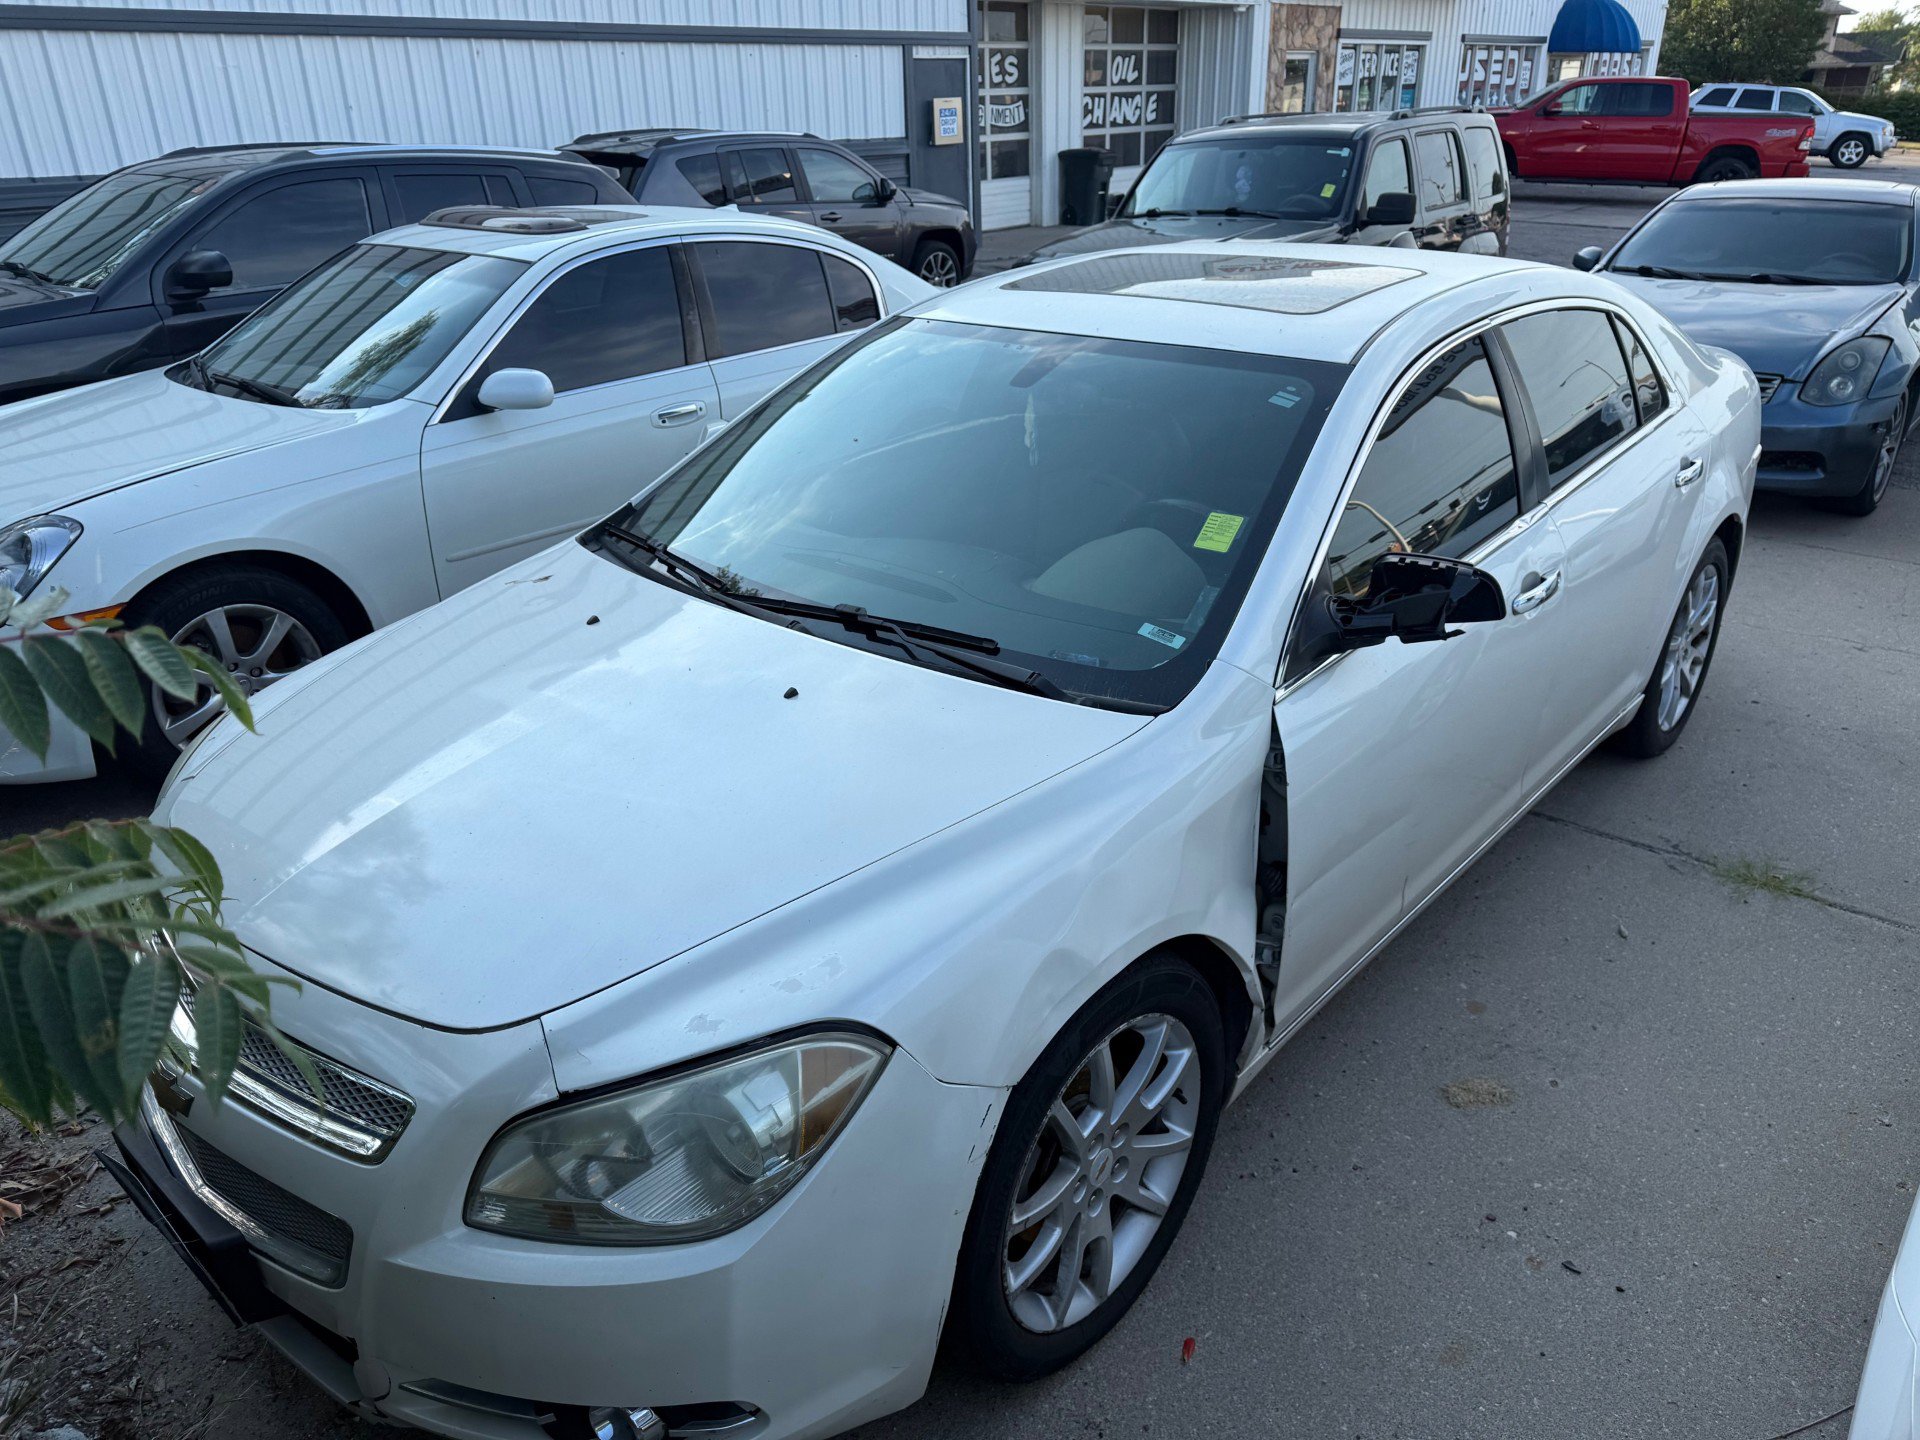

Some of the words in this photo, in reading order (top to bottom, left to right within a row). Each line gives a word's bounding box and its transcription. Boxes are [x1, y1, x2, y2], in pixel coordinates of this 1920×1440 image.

[1111, 54, 1139, 84] OIL
[1359, 52, 1400, 78] SERVICE
[1459, 49, 1519, 86] USED
[940, 117, 957, 126] DROP
[1082, 92, 1158, 128] CHANGE
[942, 127, 956, 135] BOX
